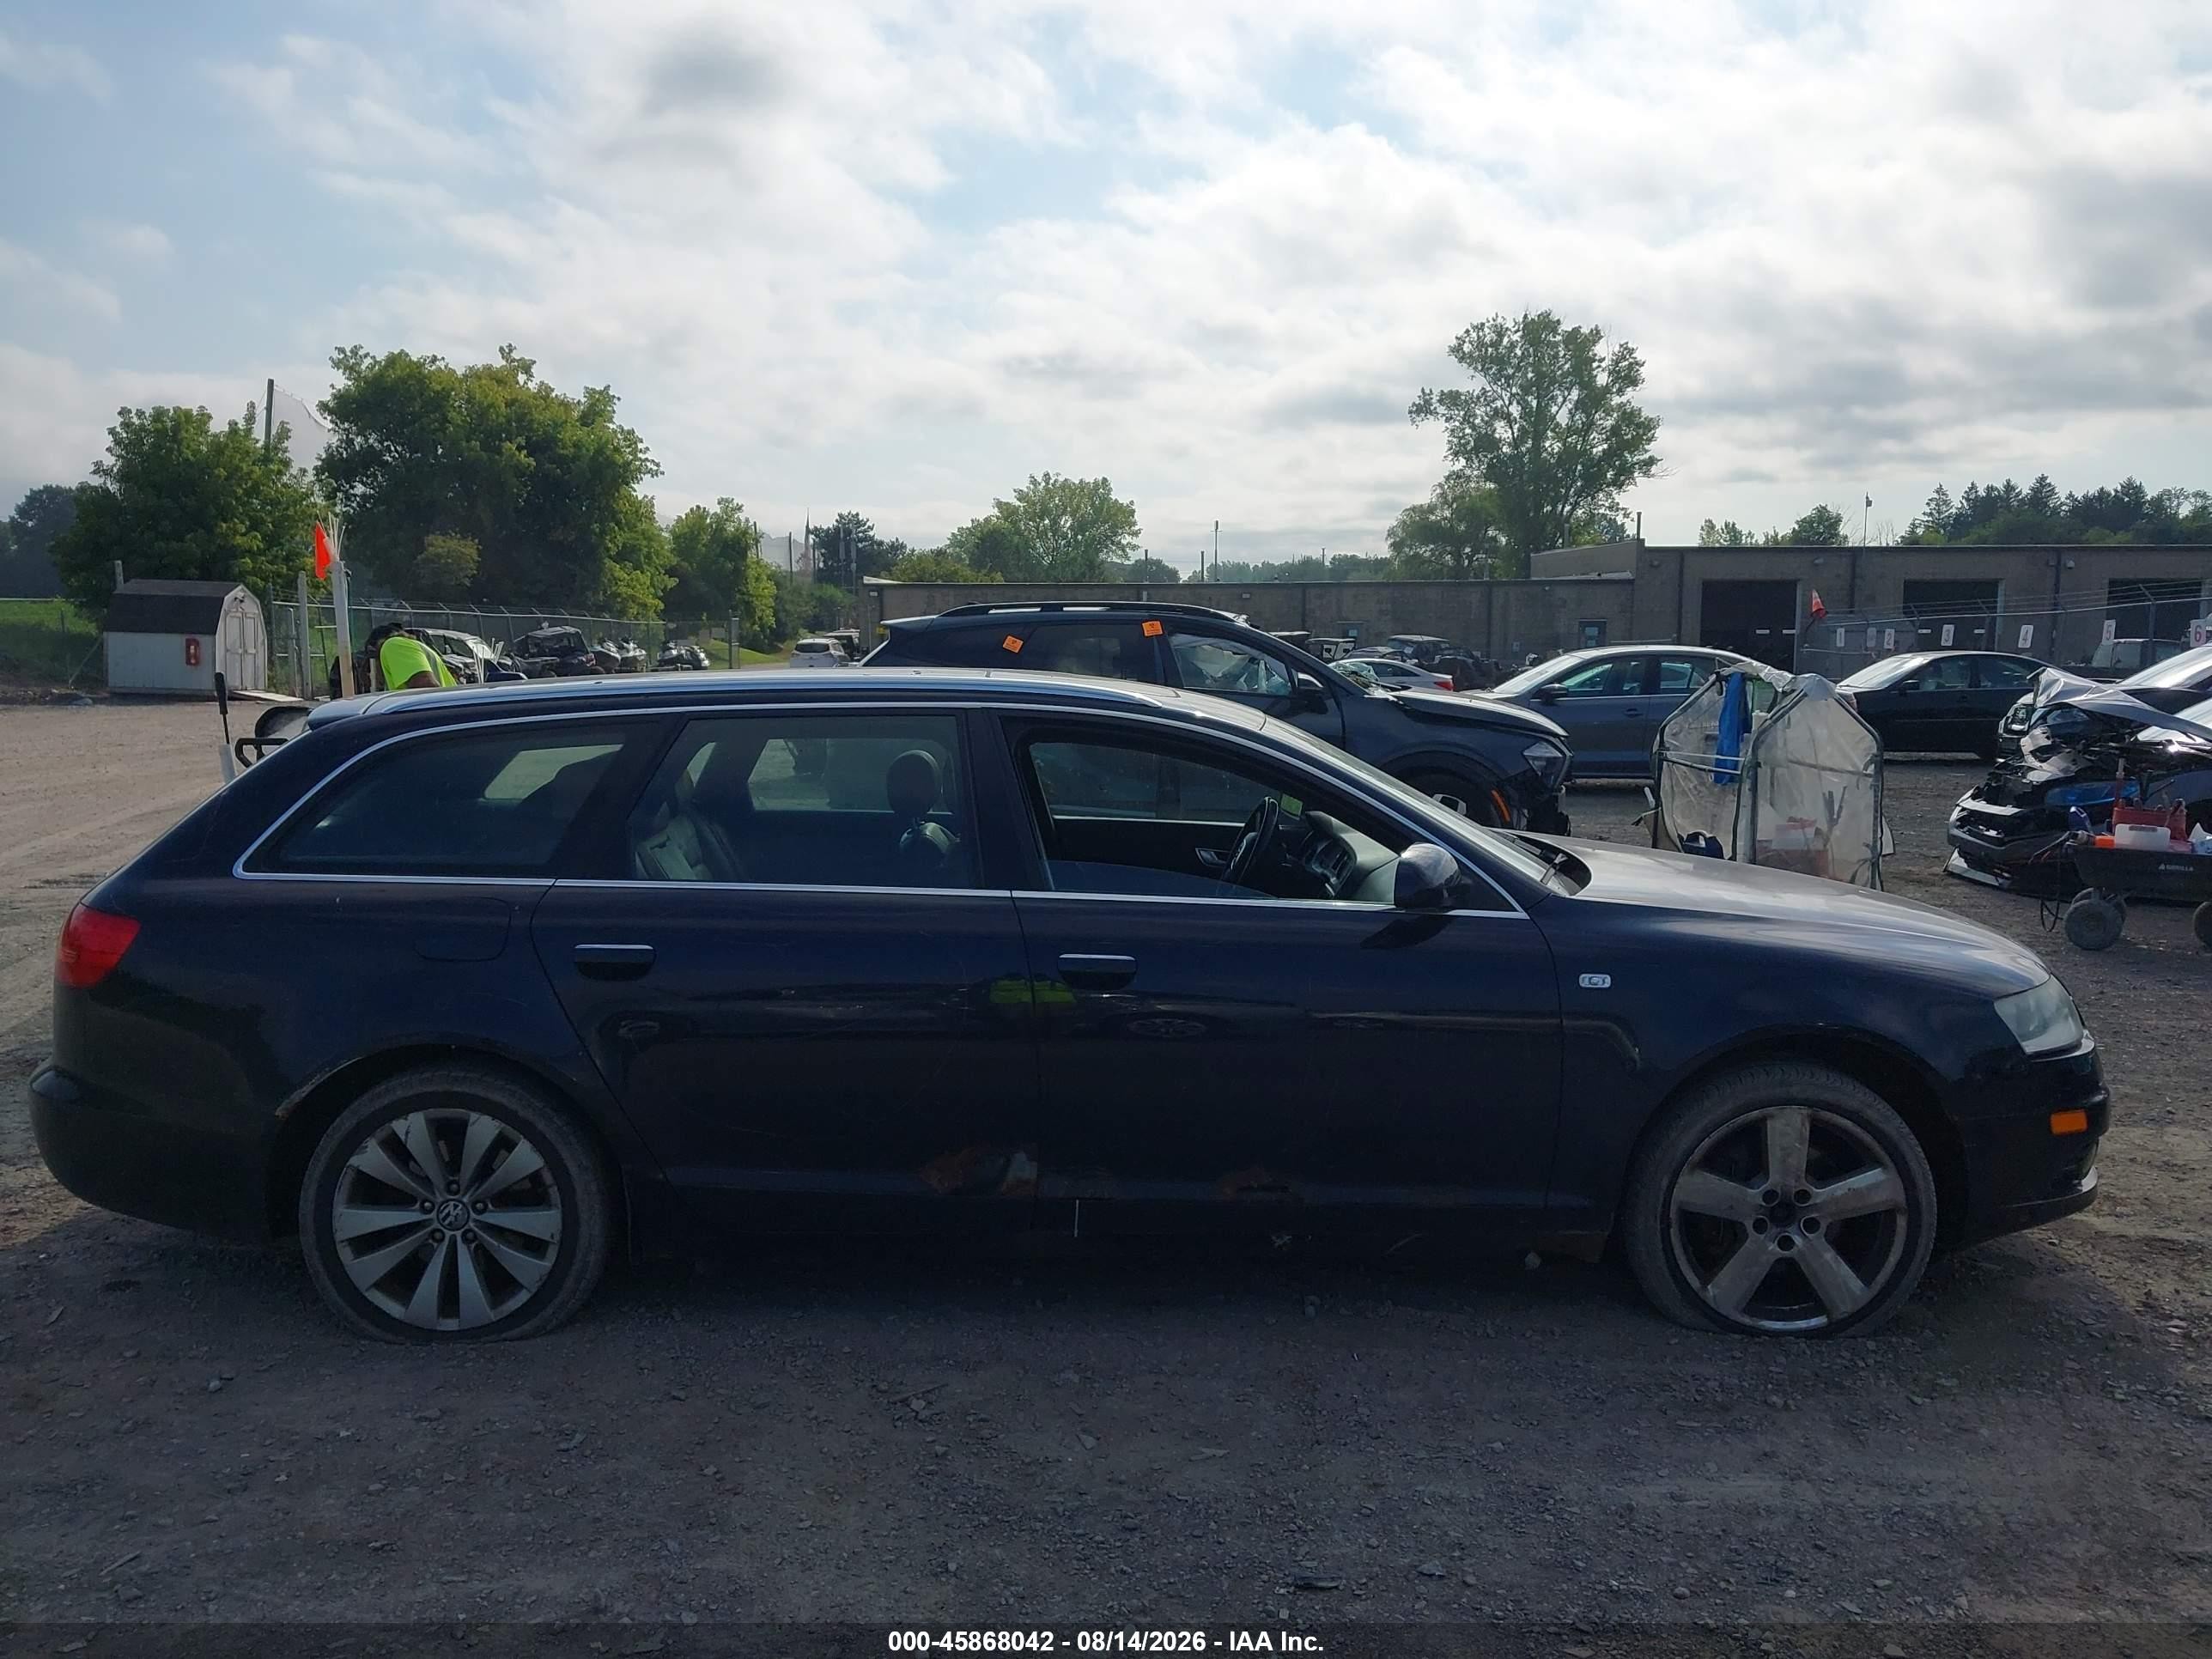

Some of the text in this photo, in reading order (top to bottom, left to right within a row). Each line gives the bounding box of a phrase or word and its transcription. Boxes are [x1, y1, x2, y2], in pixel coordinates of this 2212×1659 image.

[1886, 632, 1893, 646] 2
[1943, 629, 1951, 642] 3
[2021, 629, 2029, 644] 4
[2106, 623, 2112, 641] 5
[2194, 624, 2202, 642] 6
